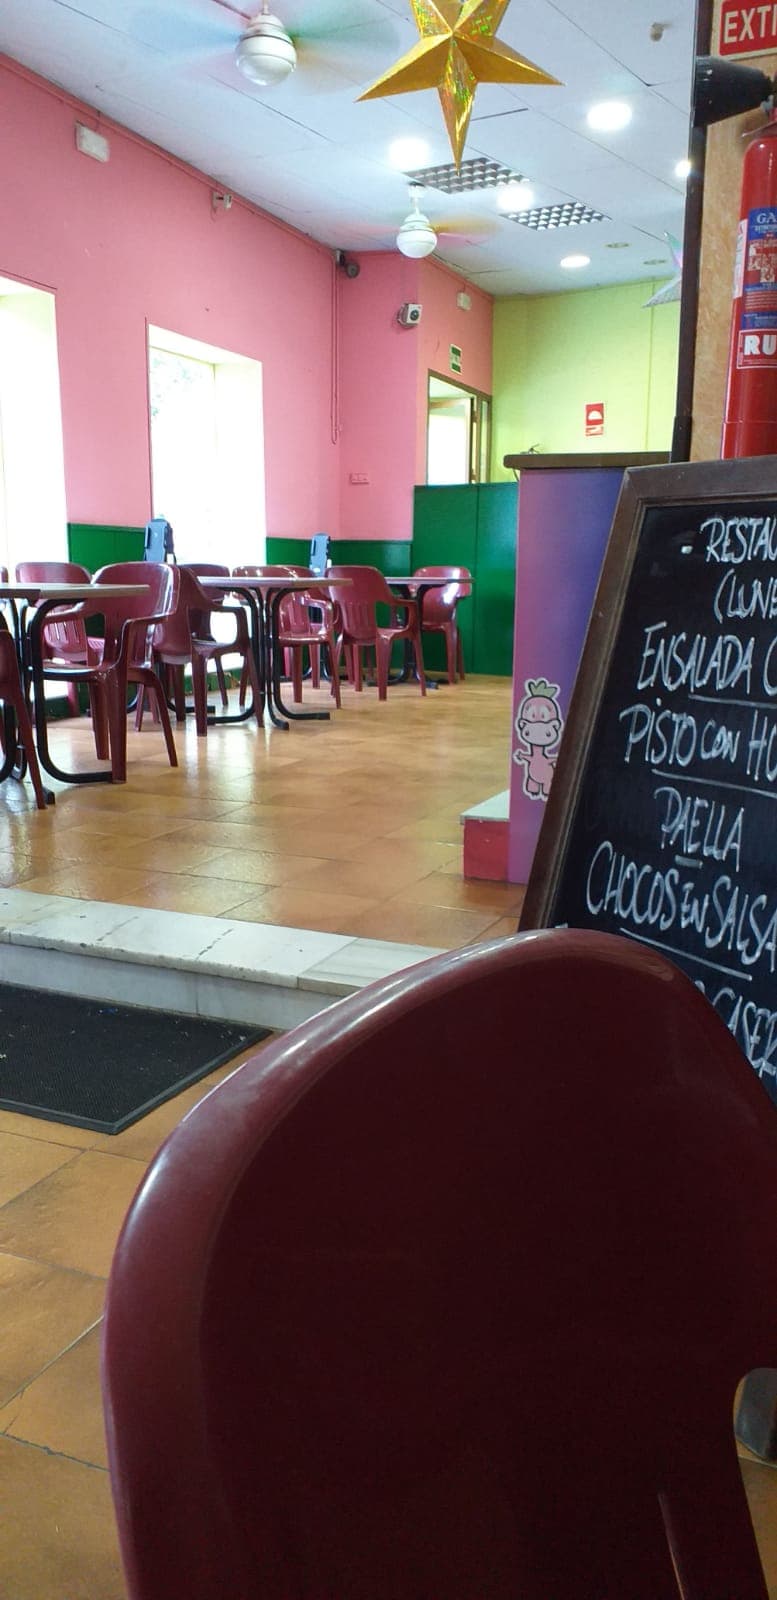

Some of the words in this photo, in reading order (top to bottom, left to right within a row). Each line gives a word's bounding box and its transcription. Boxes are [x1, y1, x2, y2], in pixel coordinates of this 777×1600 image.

[743, 334, 776, 356] RU
[637, 621, 755, 695] ENSALADA
[654, 786, 745, 872] PAELLA
[586, 840, 679, 931] CHOCOS
[705, 875, 777, 974] SALSA
